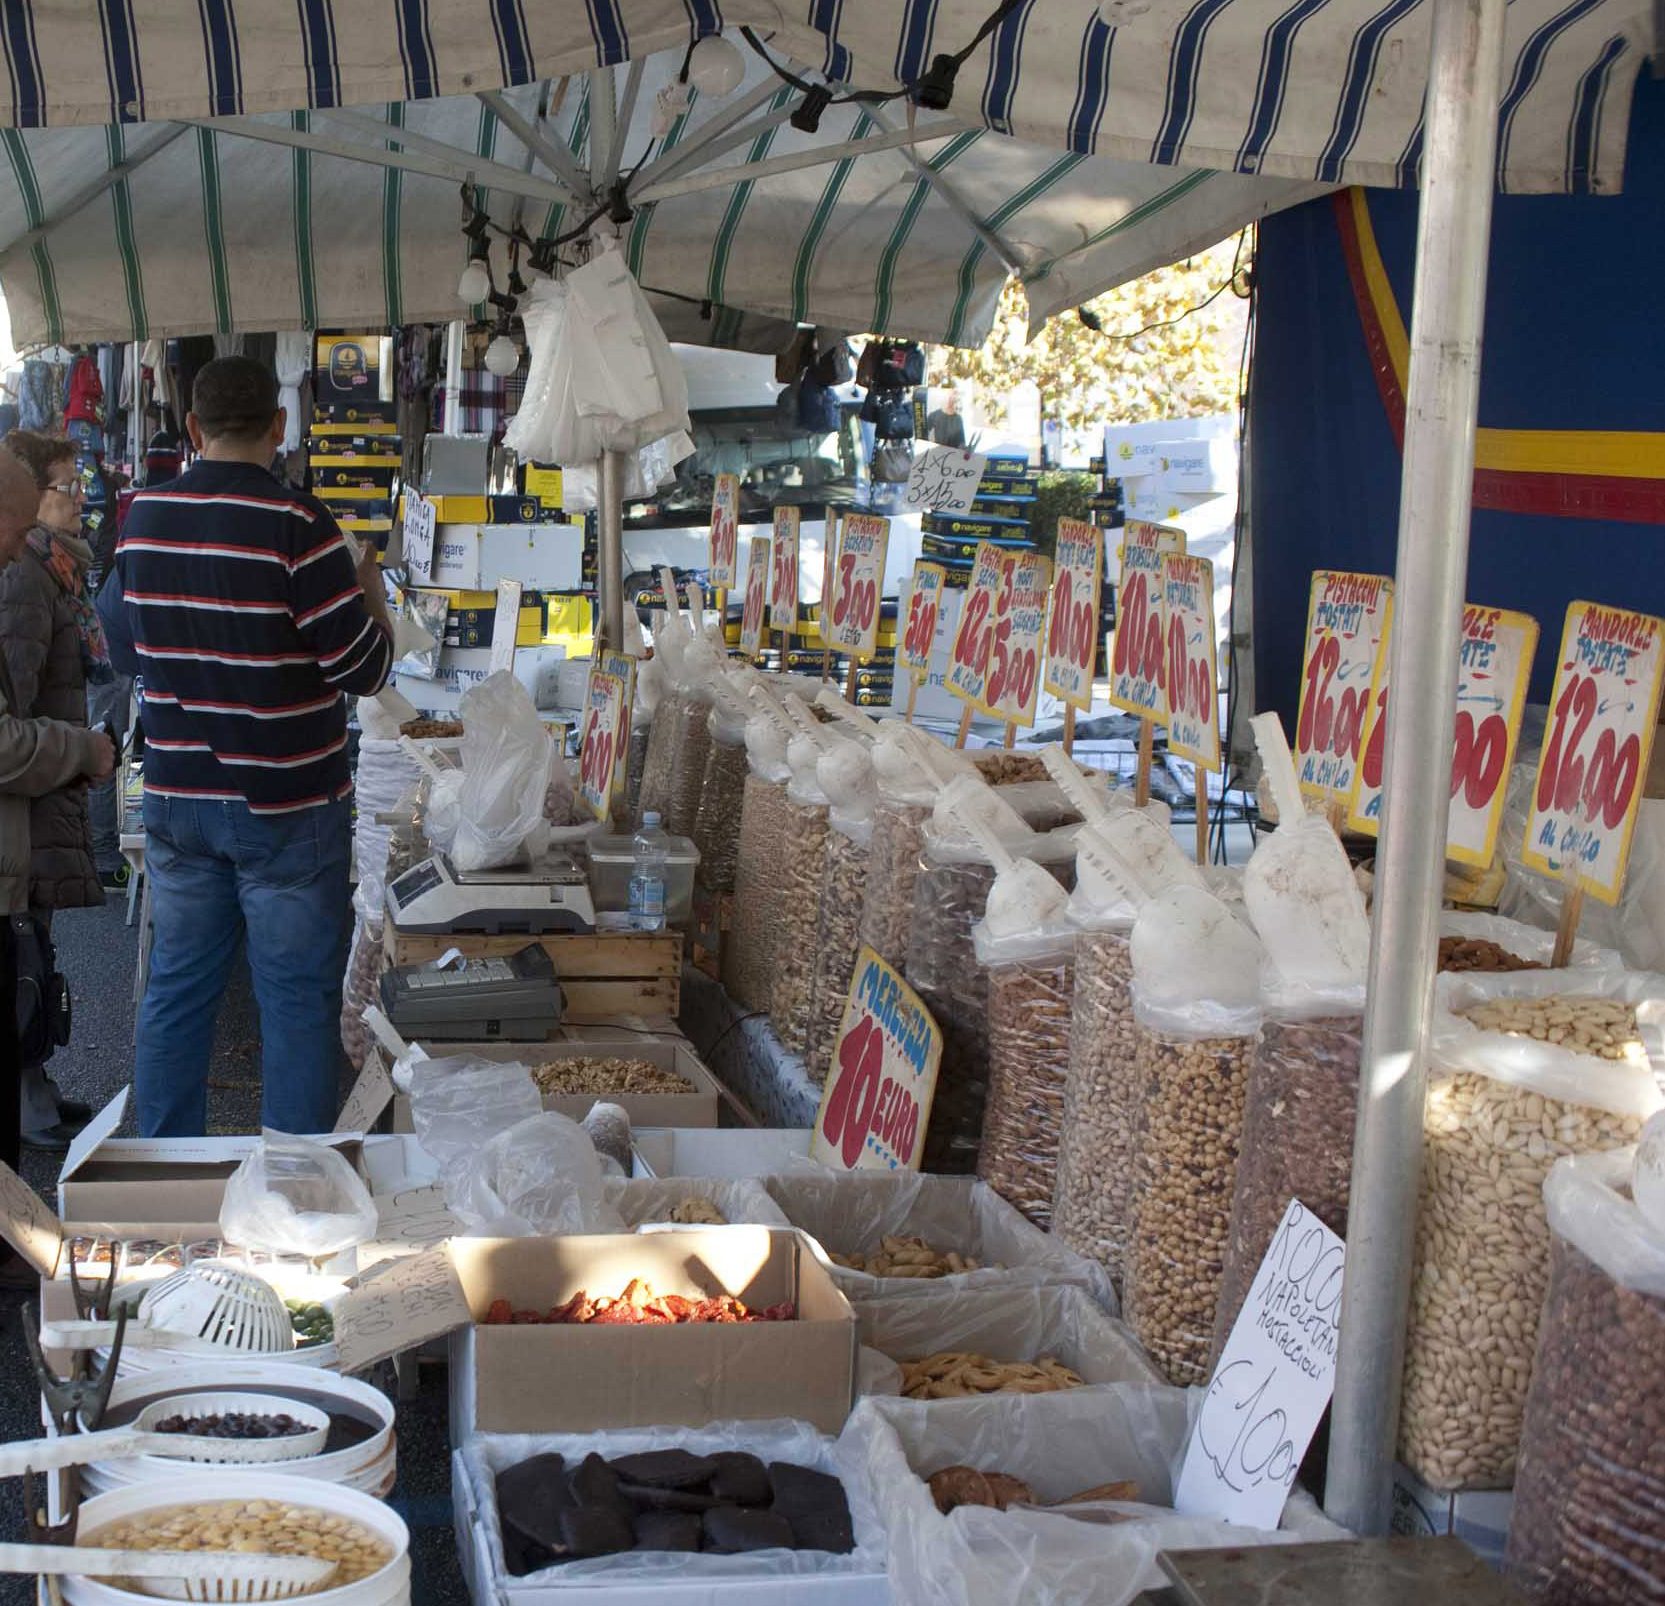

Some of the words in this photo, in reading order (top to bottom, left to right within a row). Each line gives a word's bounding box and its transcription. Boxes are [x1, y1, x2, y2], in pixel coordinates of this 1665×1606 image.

[1324, 572, 1382, 608] PISTACCHI
[1579, 604, 1658, 651] MANDORLE
[870, 1076, 919, 1166] EURO
